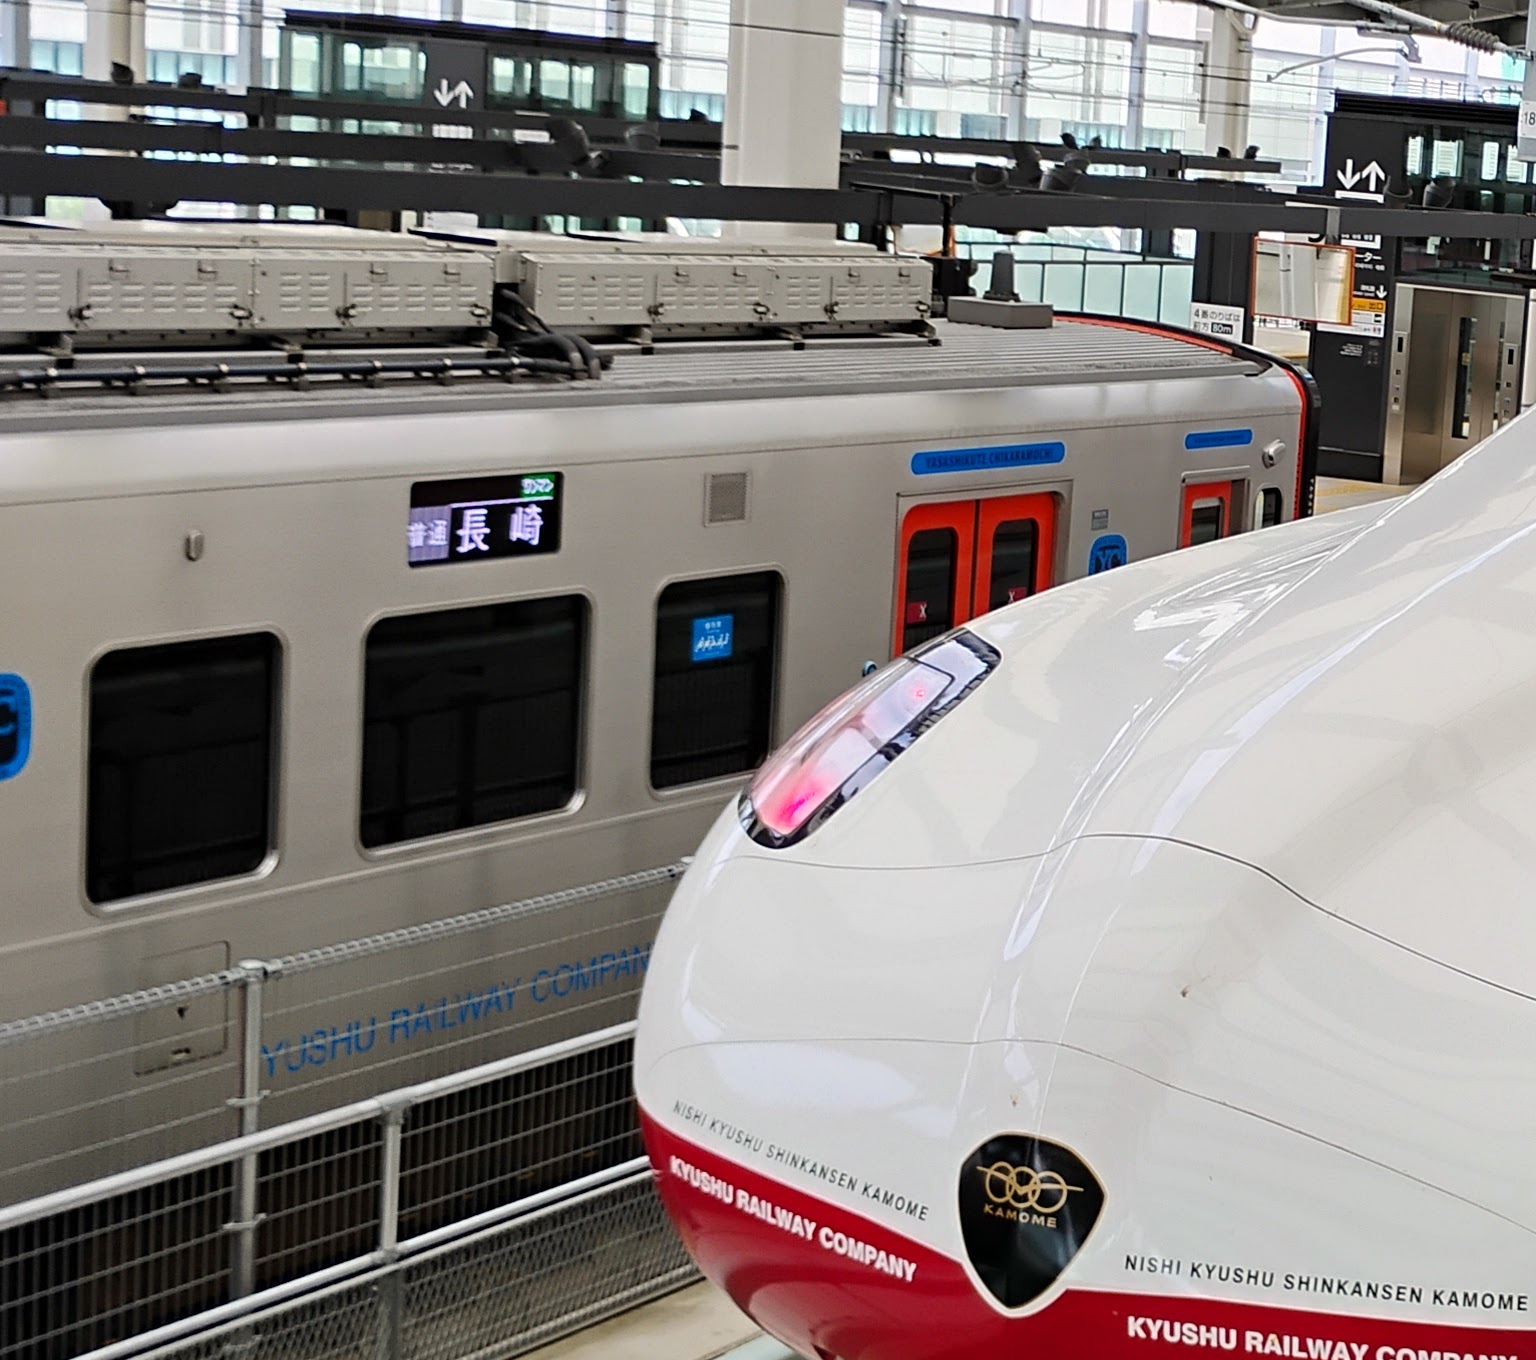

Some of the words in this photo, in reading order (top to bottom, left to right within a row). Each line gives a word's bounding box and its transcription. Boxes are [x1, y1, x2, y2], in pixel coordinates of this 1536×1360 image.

[456, 504, 544, 553] 長崎
[261, 1016, 376, 1078] YUSHU
[531, 942, 651, 1004] COMPAN
[673, 1099, 707, 1128] NISHI
[710, 1116, 765, 1153] KYUSHU
[766, 1143, 858, 1192] SHINKANSEN
[861, 1181, 930, 1222] KAMOME
[670, 1154, 734, 1205] KYUSHU
[736, 1189, 816, 1241] RAILWAY
[819, 1226, 918, 1283] COMPANY
[983, 1203, 1057, 1228] KAMOME
[1124, 1254, 1182, 1276] NISHI
[1190, 1261, 1275, 1288] KYUSHU
[1283, 1273, 1423, 1304] SHINKANSEN
[1433, 1289, 1530, 1312] KAMOME
[1127, 1315, 1238, 1350] KYUSHU
